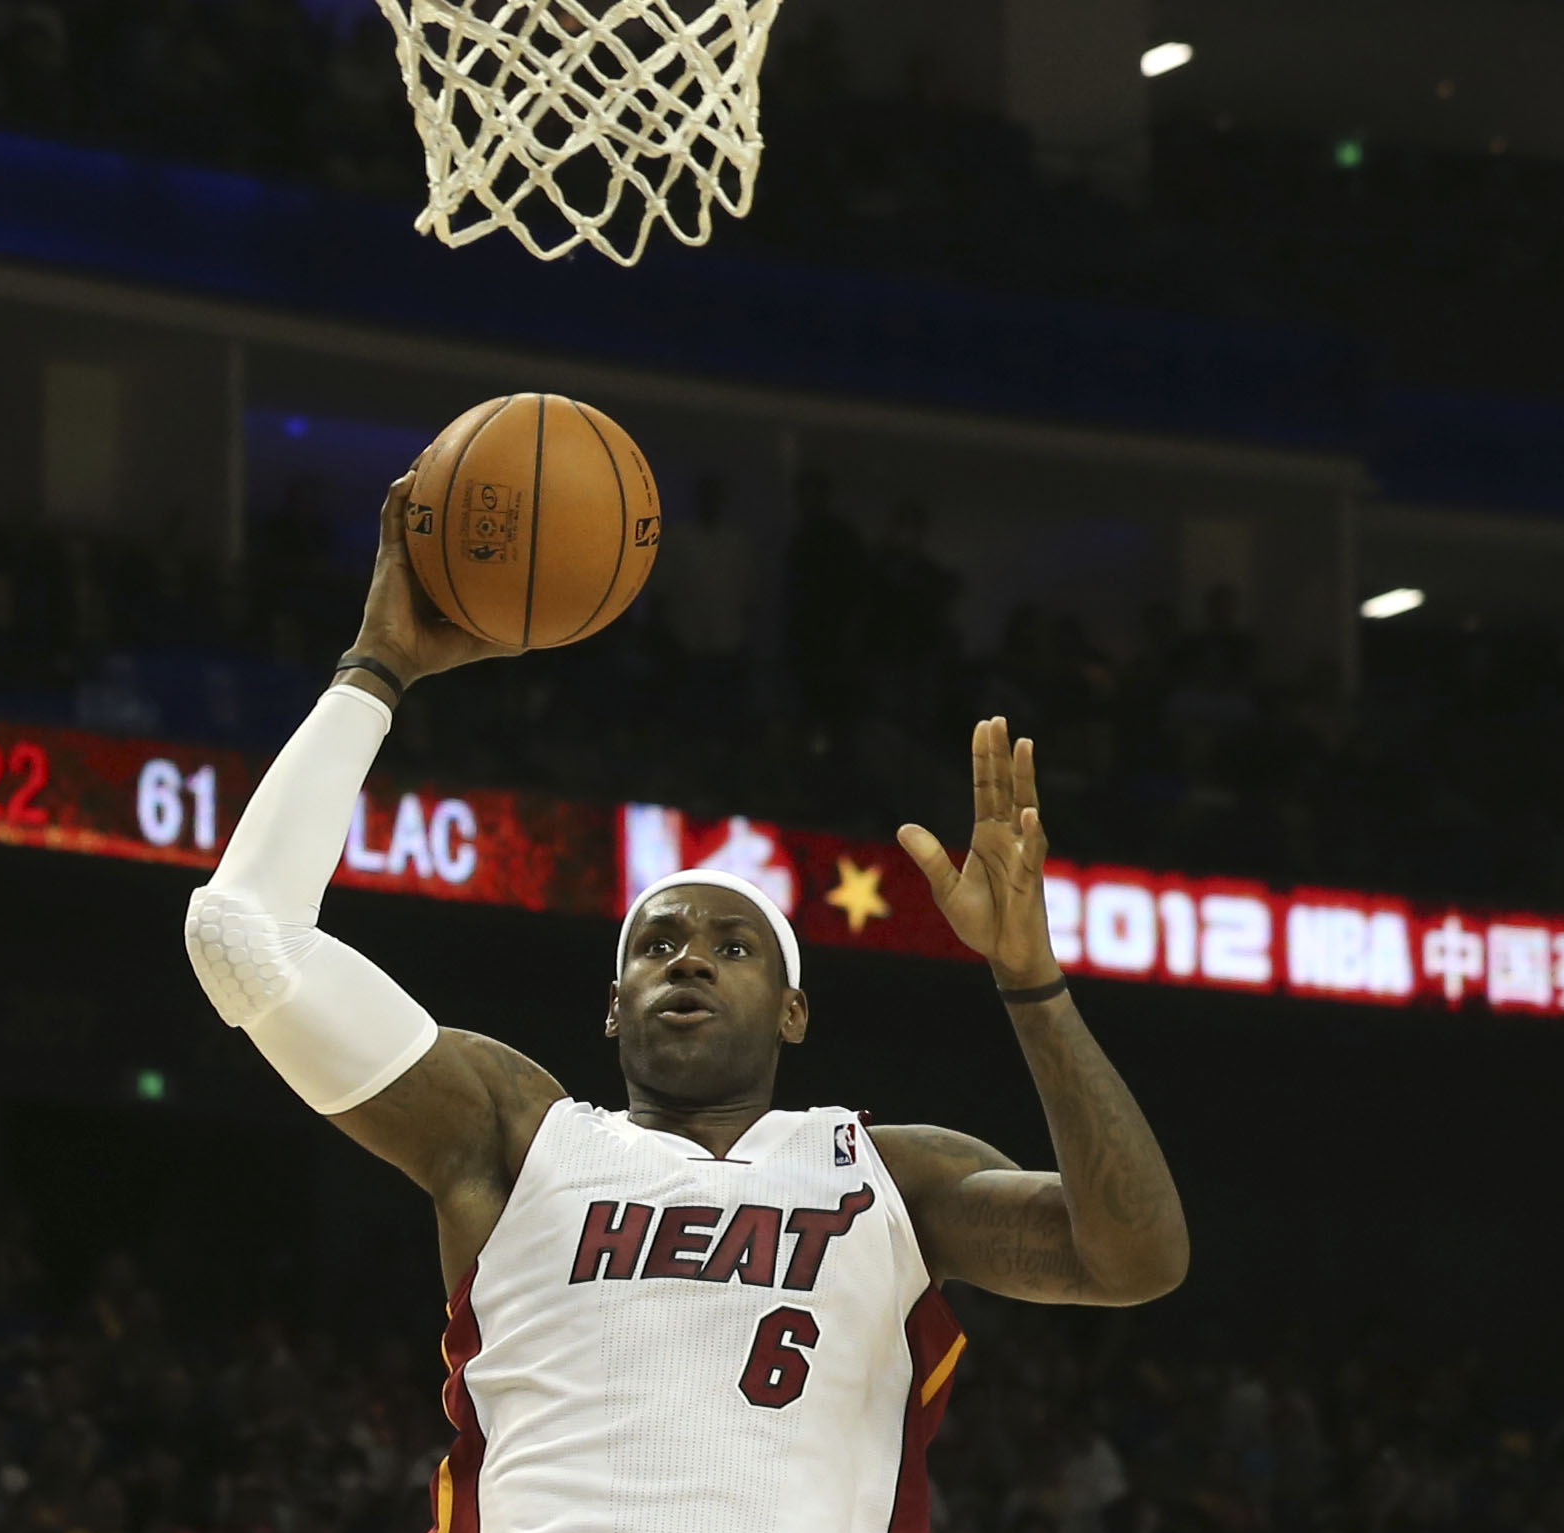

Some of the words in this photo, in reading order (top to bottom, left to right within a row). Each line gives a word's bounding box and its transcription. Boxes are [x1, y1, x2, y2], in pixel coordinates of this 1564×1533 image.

[138, 758, 217, 849] 61
[344, 791, 478, 885] LAC
[1043, 875, 1272, 985] 2012
[569, 1182, 875, 1291] HEAT
[739, 1304, 820, 1409] 6
